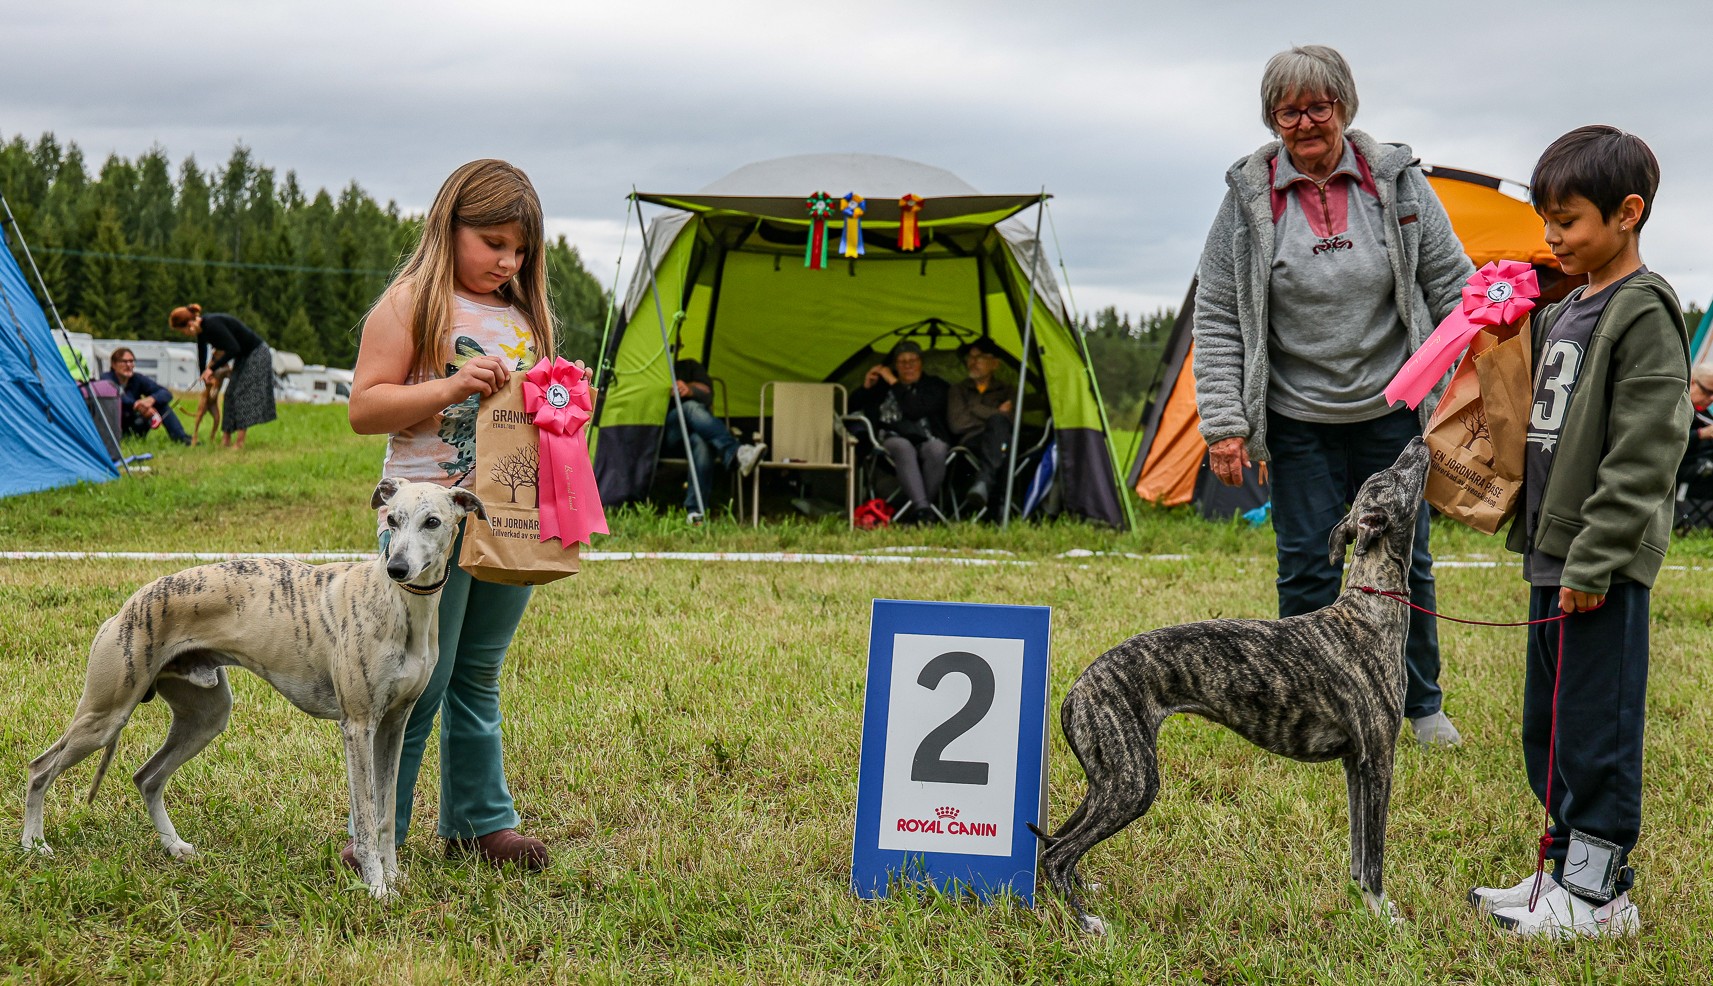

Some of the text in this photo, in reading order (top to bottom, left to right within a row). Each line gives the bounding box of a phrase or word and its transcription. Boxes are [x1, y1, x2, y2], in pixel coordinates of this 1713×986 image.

[1530, 339, 1584, 431] 3
[492, 409, 534, 425] GRANNG
[1433, 449, 1447, 463] EN
[1444, 457, 1486, 489] JORDNÄRA
[492, 516, 540, 531] EN JORDNÄR
[521, 532, 529, 540] av
[911, 651, 996, 786] 2
[897, 818, 997, 837] ROYAL CANIN
